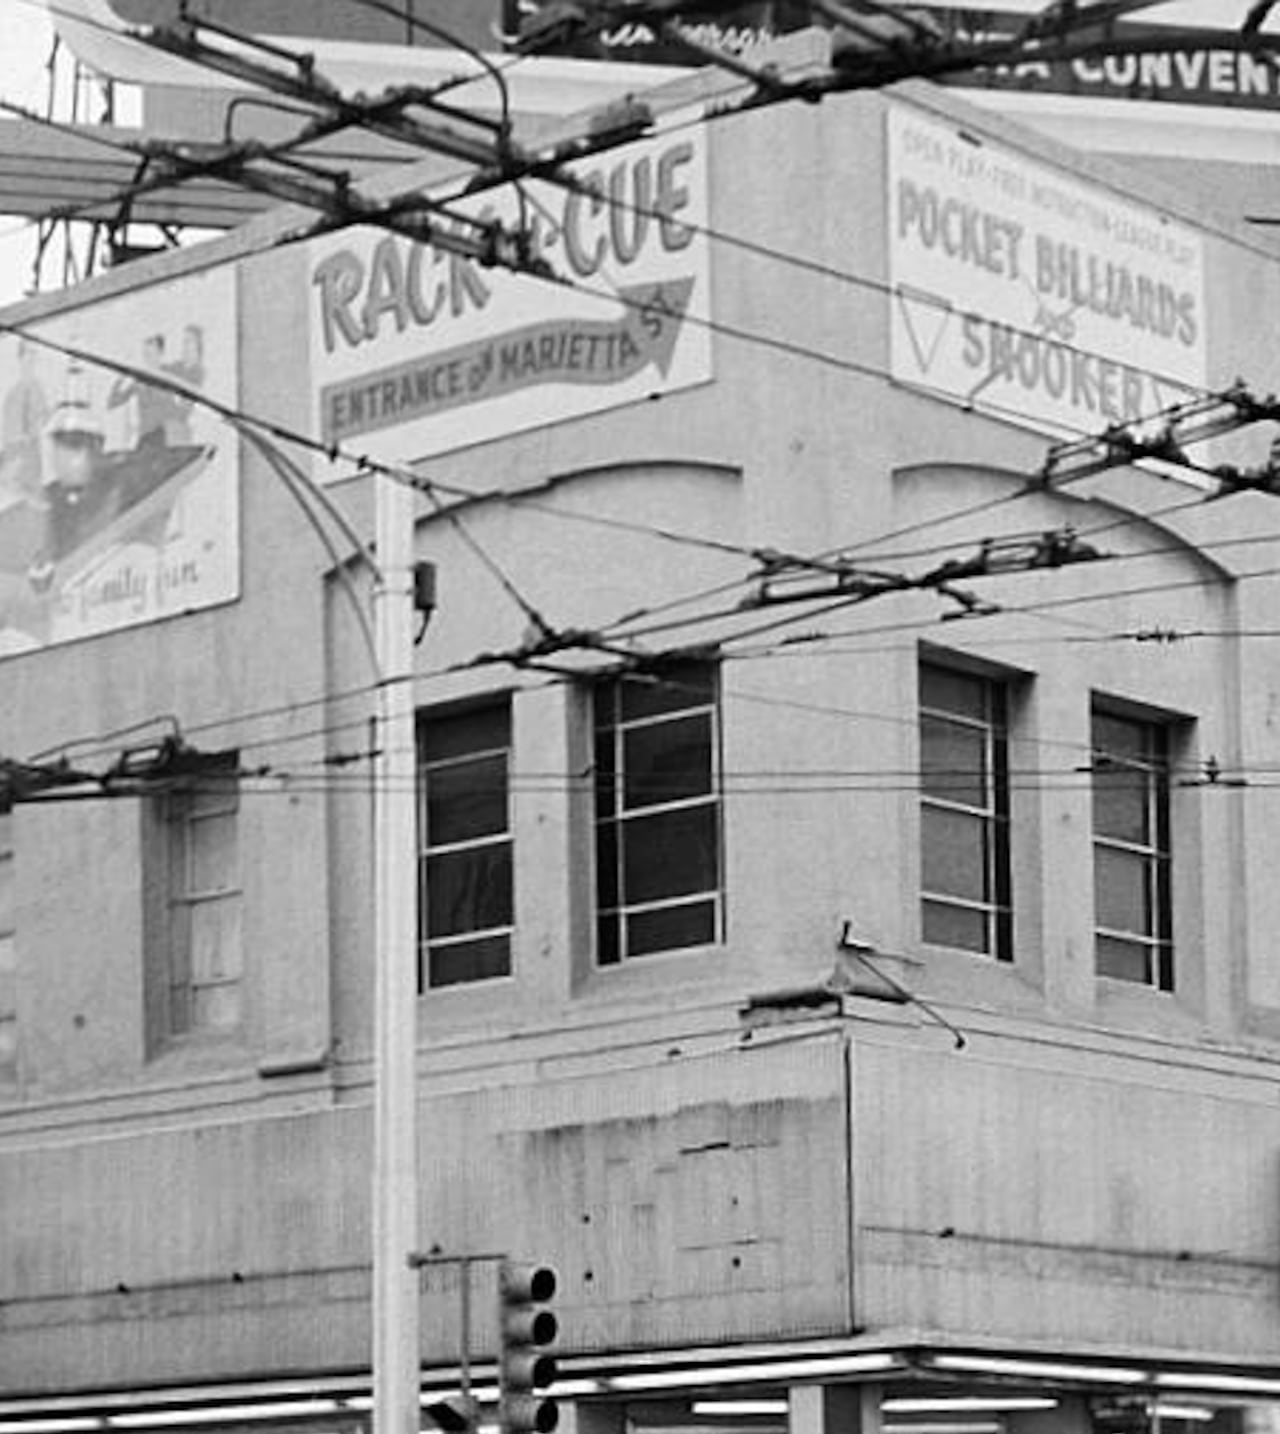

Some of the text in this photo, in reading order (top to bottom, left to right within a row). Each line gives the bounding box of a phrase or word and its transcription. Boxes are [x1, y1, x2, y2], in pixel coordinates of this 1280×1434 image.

[562, 140, 697, 278] CUE
[898, 178, 1198, 348] POCKET BILLIARDS
[331, 360, 462, 432] ENTRANCE
[500, 330, 640, 381] MARIETTA
[963, 316, 1144, 422] SNOOKER
